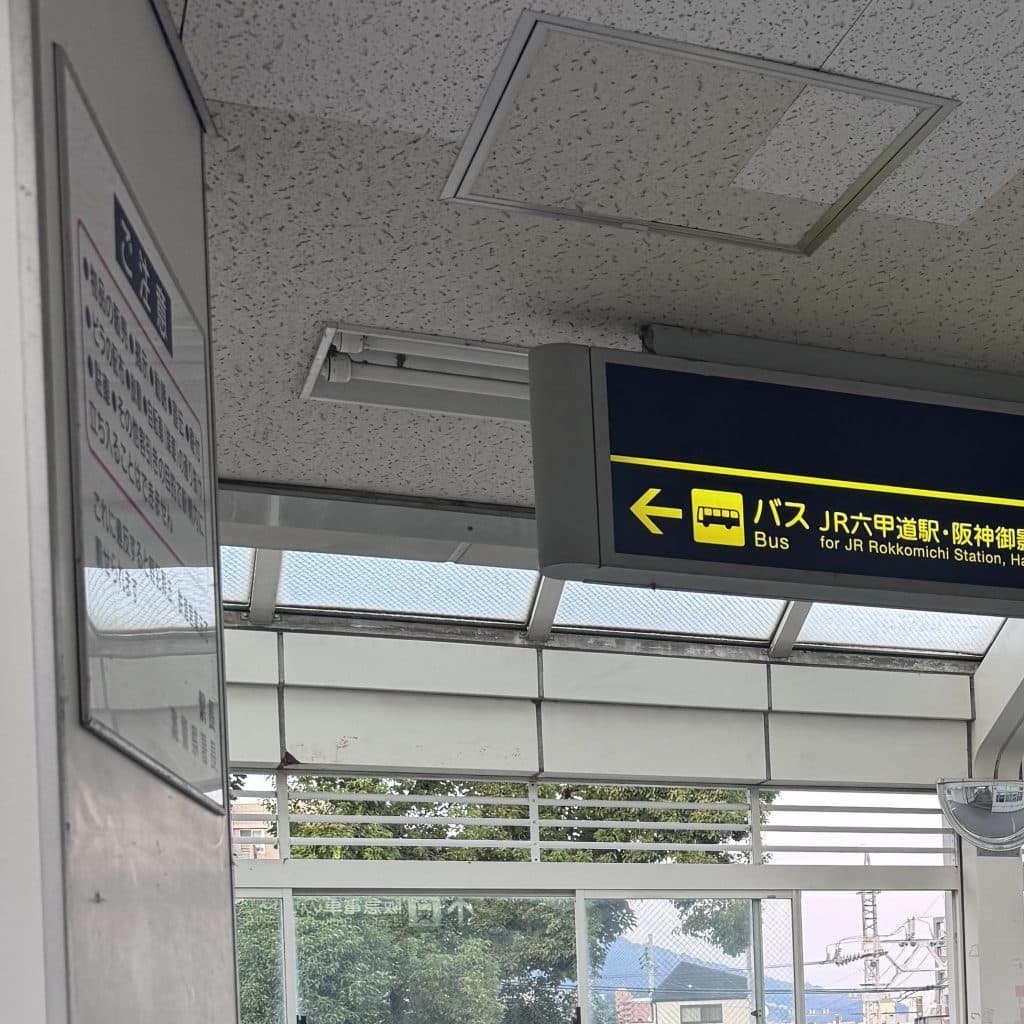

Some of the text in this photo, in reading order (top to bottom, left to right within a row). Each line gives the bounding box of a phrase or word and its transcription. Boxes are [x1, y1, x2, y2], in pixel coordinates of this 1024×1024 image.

[120, 217, 168, 343] ご注意
[753, 498, 810, 530] バス
[754, 531, 790, 550] Bus
[820, 535, 840, 549] for
[845, 537, 864, 552] JR
[869, 540, 949, 561] Rokkomichi
[954, 547, 1006, 566] Station,
